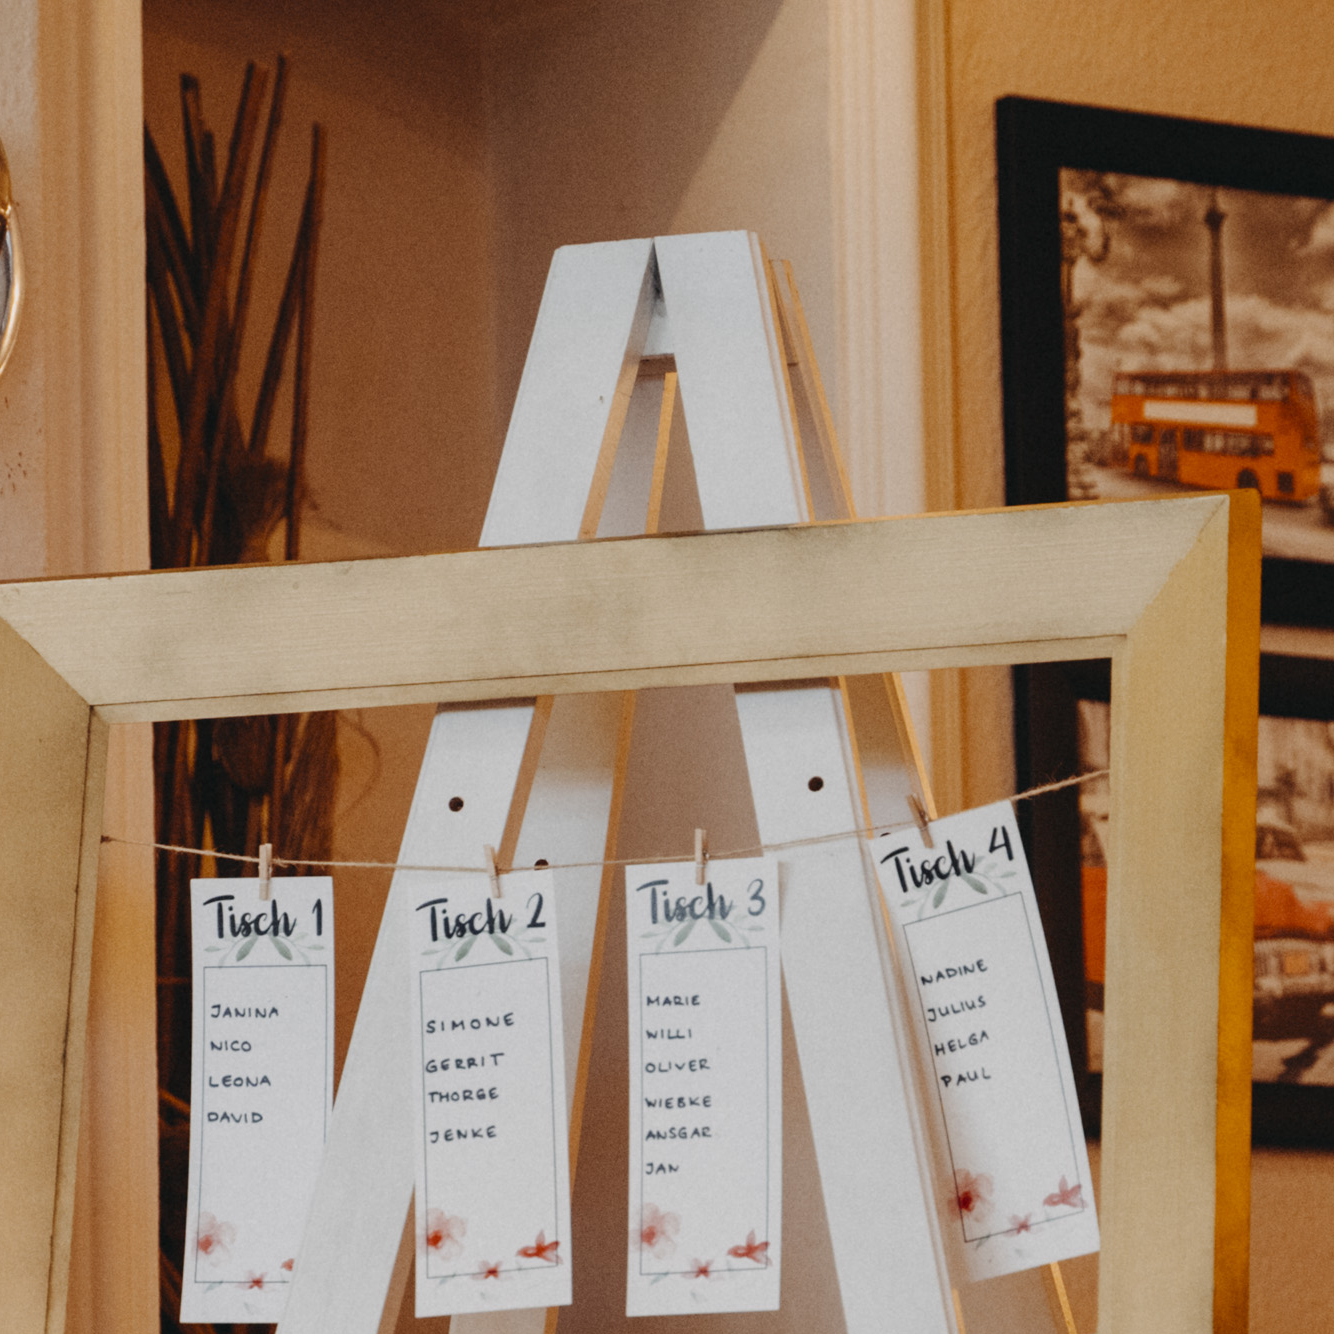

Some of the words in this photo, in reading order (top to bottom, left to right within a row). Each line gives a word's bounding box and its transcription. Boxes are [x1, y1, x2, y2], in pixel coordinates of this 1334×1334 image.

[880, 839, 976, 893] Tisch
[988, 825, 1014, 861] 4
[636, 879, 734, 925] Tisch
[746, 878, 766, 917] 3
[202, 894, 297, 939] Tisch
[312, 898, 323, 937] 1
[415, 897, 513, 942] Tisch
[526, 893, 546, 929] 2
[920, 959, 988, 986] NADINE
[646, 994, 701, 1007] MARIE
[927, 996, 987, 1022] JULIUS
[210, 1004, 279, 1019] JANINA
[425, 1012, 515, 1034] SIMONE
[210, 1040, 252, 1053] NICO
[934, 1030, 990, 1057] HELGA
[425, 1053, 505, 1074] GERRIT
[645, 1058, 711, 1074] OLIVER
[208, 1075, 271, 1088] LEONA
[940, 1067, 991, 1088] PAUL
[428, 1087, 499, 1103] THORGE
[644, 1096, 713, 1109] WIEBKE
[207, 1112, 263, 1124] DAVID
[429, 1126, 497, 1144] JENKE
[645, 1127, 712, 1142] ANSGAR
[645, 1163, 680, 1176] JAN
